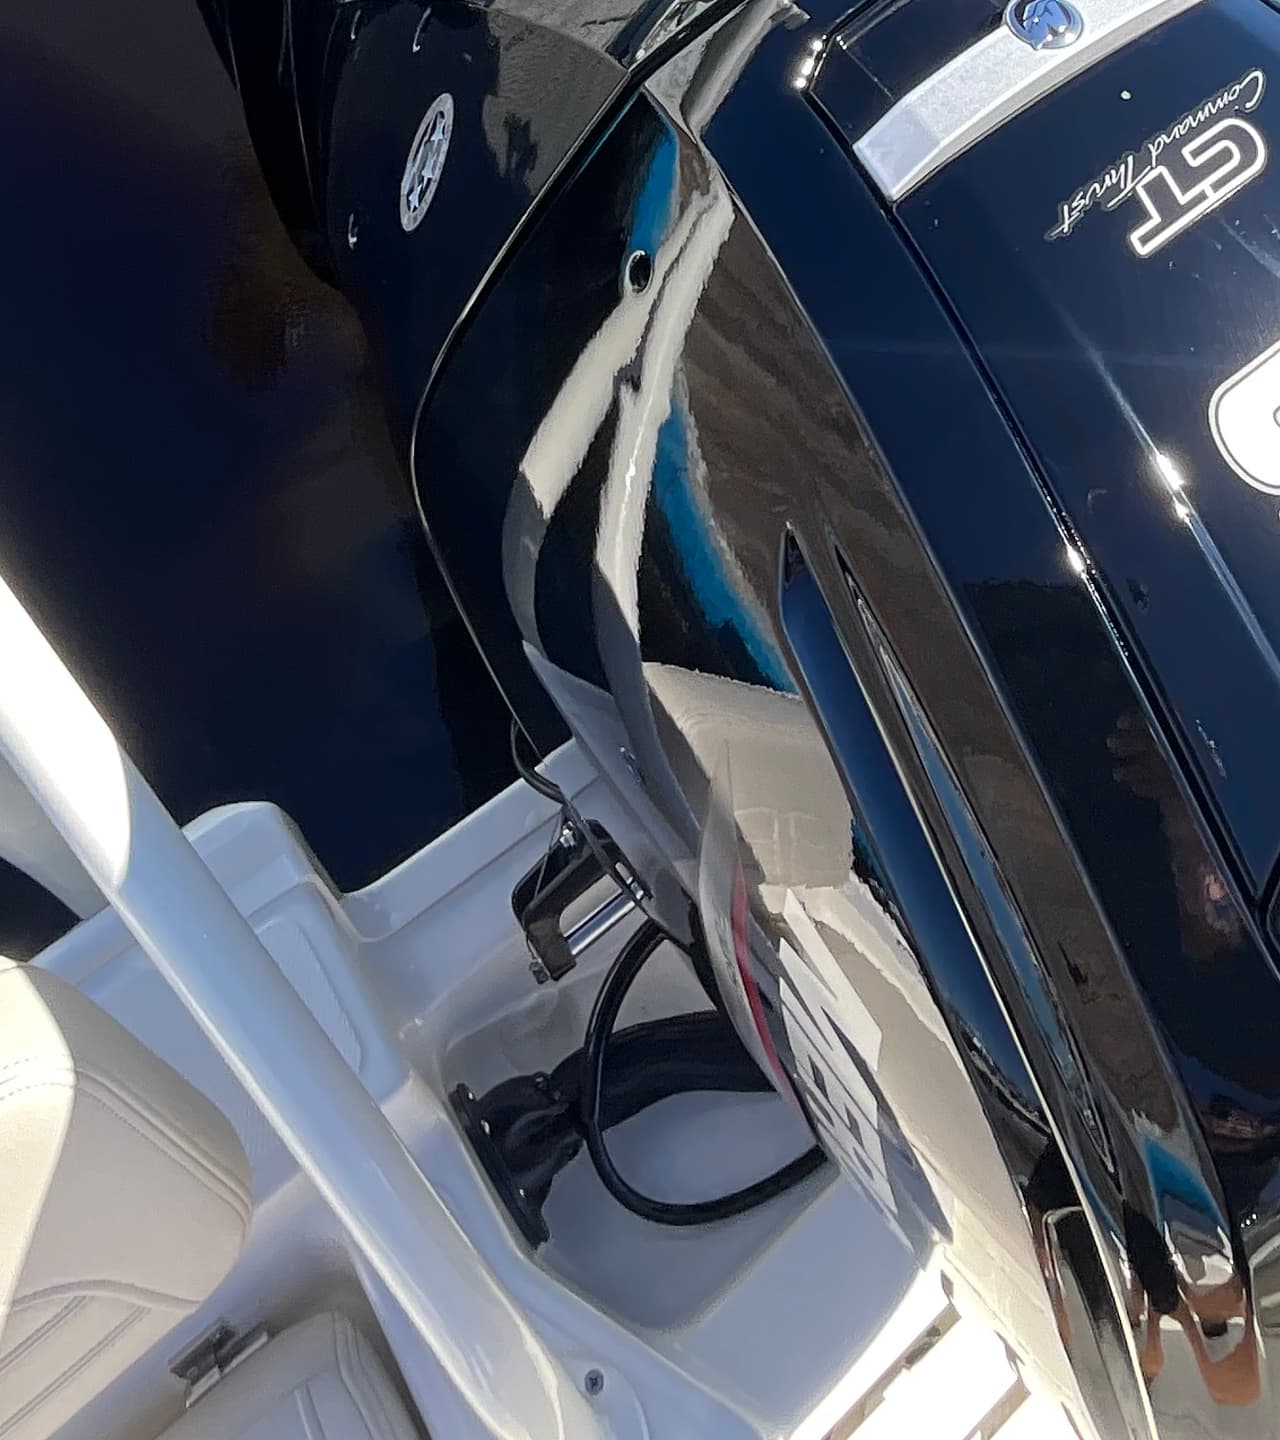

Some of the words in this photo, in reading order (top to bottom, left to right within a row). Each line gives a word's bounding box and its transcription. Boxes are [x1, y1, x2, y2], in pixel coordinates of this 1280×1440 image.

[1147, 69, 1265, 168] Command
[1047, 154, 1151, 239] Thrust
[1129, 117, 1266, 256] GT
